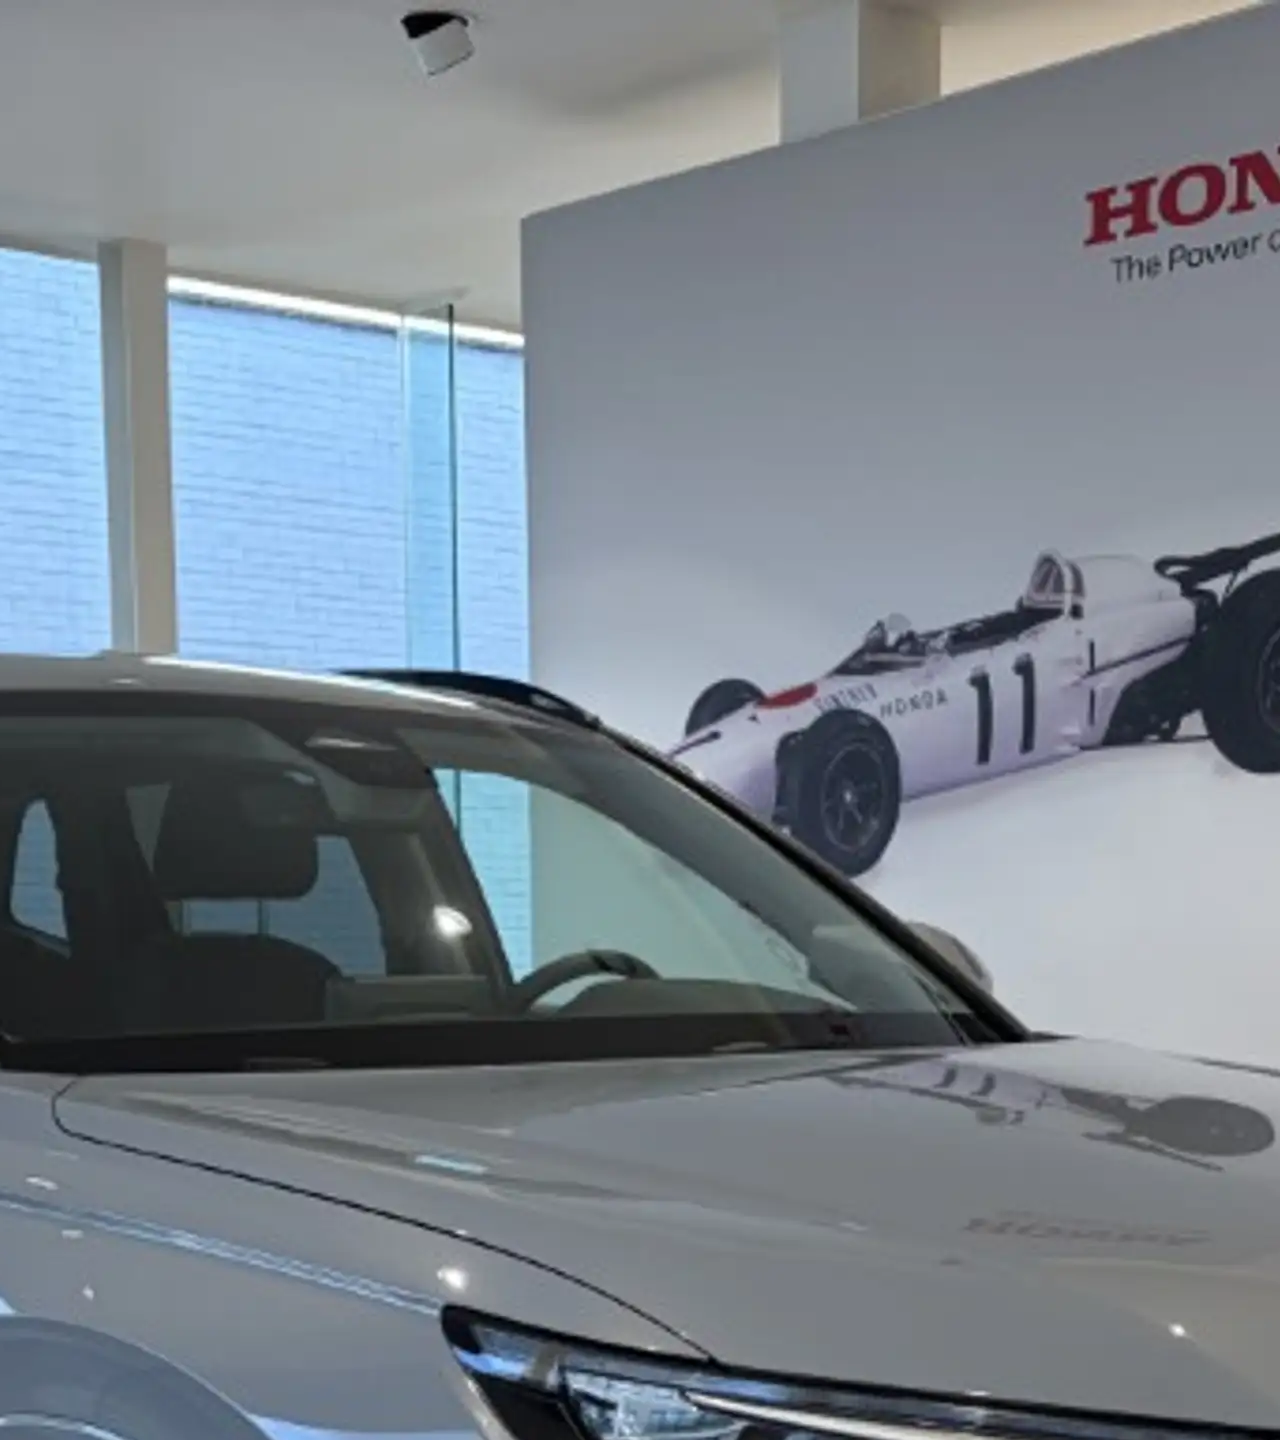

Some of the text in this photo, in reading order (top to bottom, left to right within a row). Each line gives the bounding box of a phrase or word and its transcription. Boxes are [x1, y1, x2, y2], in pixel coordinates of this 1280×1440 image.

[1110, 254, 1162, 284] The
[1168, 230, 1262, 274] Power
[879, 687, 949, 719] HONDA
[968, 652, 1035, 766] 11
